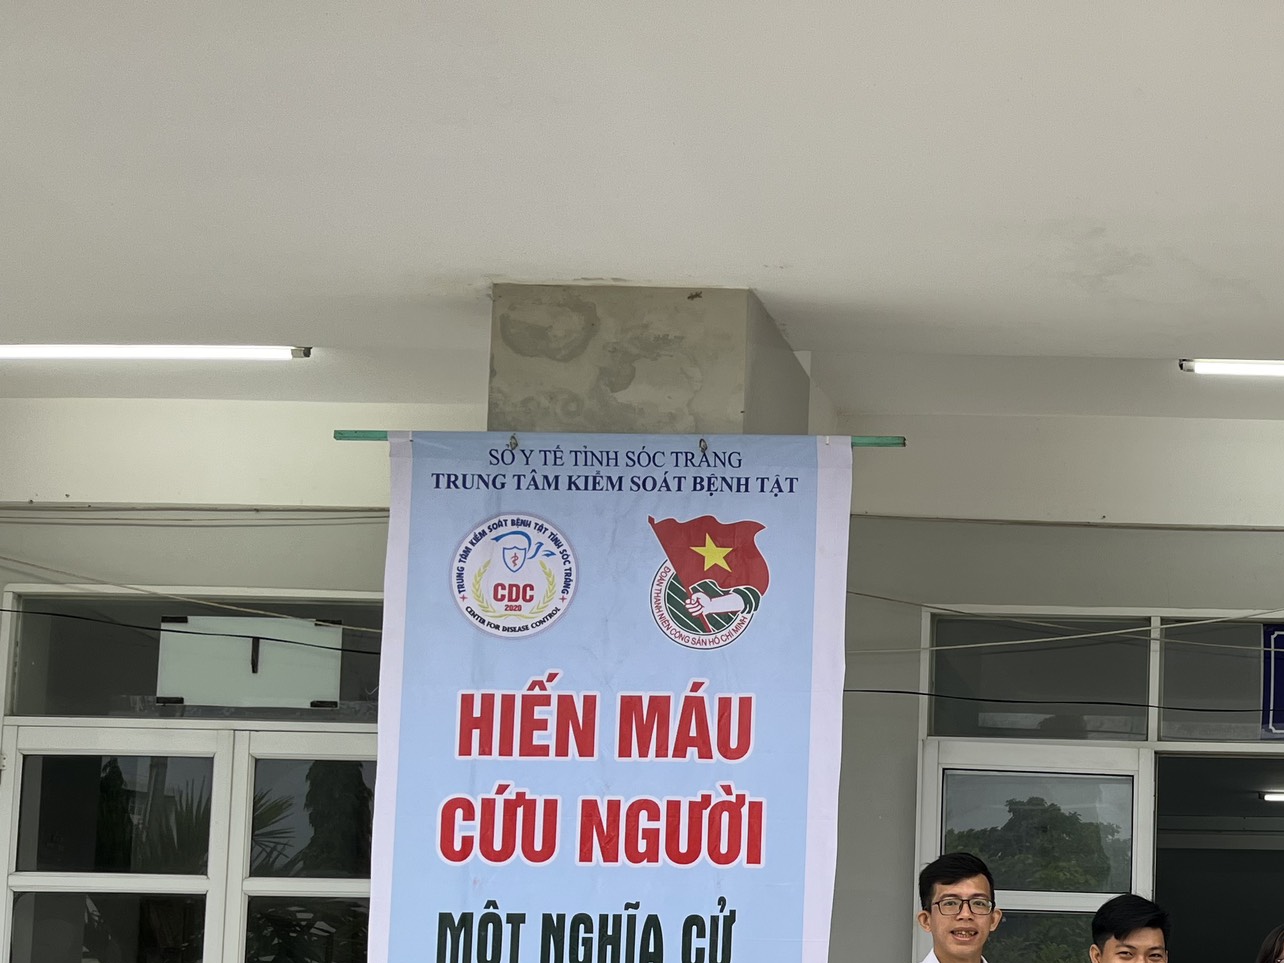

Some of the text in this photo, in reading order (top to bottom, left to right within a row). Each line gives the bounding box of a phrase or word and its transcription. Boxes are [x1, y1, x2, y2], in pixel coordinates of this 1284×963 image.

[489, 444, 516, 466] SỞ
[519, 449, 535, 466] Y
[539, 445, 564, 467] TẾ
[570, 445, 619, 467] TỈNH
[625, 446, 665, 468] SÓC
[431, 469, 799, 497] TRUNG TÂM KIỂM SOÁT BỆNH TẬT
[456, 566, 466, 594] TRUNG
[487, 519, 508, 533] SOÁT
[493, 583, 535, 603] CDC
[486, 621, 501, 631] FOR
[502, 625, 530, 633] DISEASE
[531, 607, 561, 629] CONTROL
[504, 604, 522, 612] 2020
[732, 616, 748, 635] MINH
[458, 672, 753, 761] HIẾN MÁU
[439, 784, 764, 865] CỨU NGƯỜI
